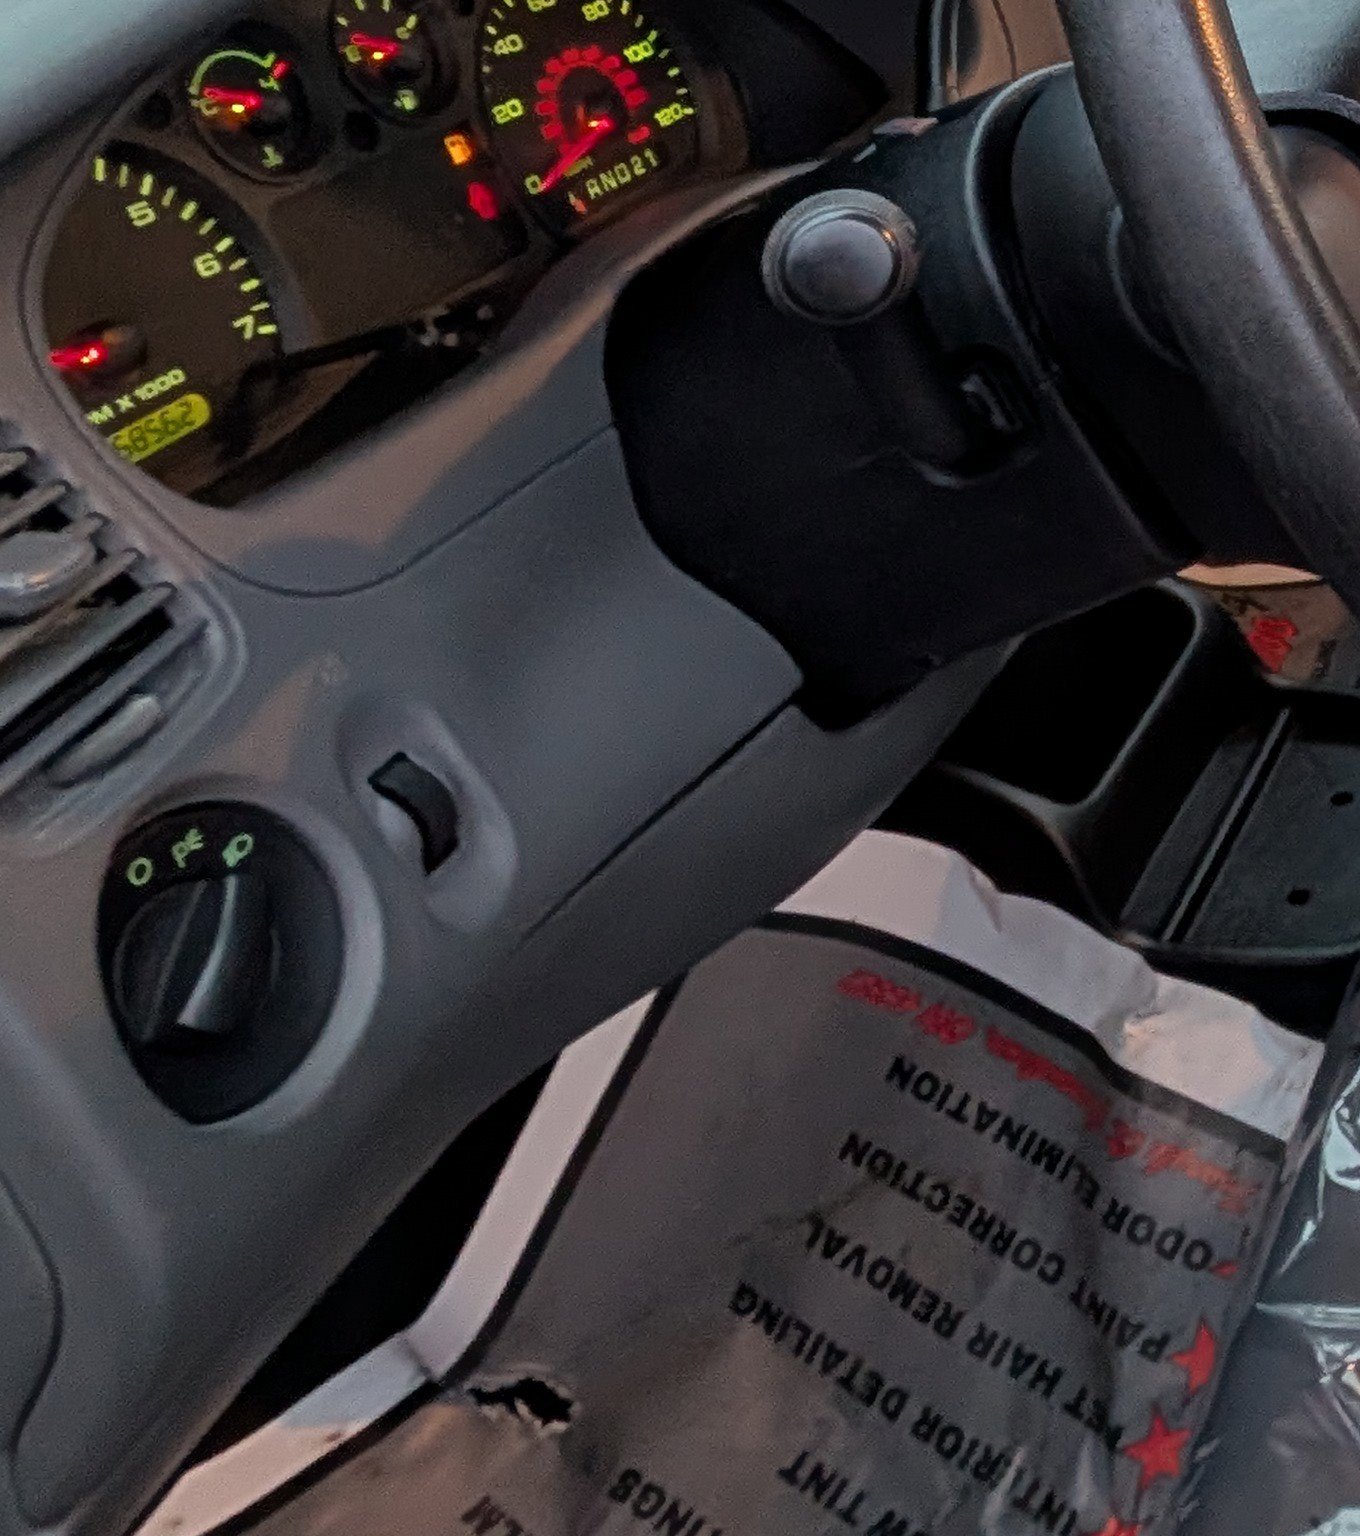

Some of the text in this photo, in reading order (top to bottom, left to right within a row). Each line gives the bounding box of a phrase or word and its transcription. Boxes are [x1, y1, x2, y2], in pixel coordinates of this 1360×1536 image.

[581, 0, 610, 21] 80
[491, 97, 525, 124] 20
[126, 200, 157, 227] 5
[194, 252, 222, 279] 6
[232, 314, 255, 340] 7
[133, 368, 185, 401] 1000
[885, 1054, 1100, 1210] ELIMINATION
[838, 1132, 1066, 1284] CORRECTION
[1102, 1197, 1213, 1272] ODOR
[803, 1210, 967, 1340] REMOVAL
[729, 1278, 910, 1421] DETAILING
[1069, 1277, 1171, 1363] PAINT
[966, 1321, 1064, 1399] HAIR
[777, 1449, 866, 1526] TINT
